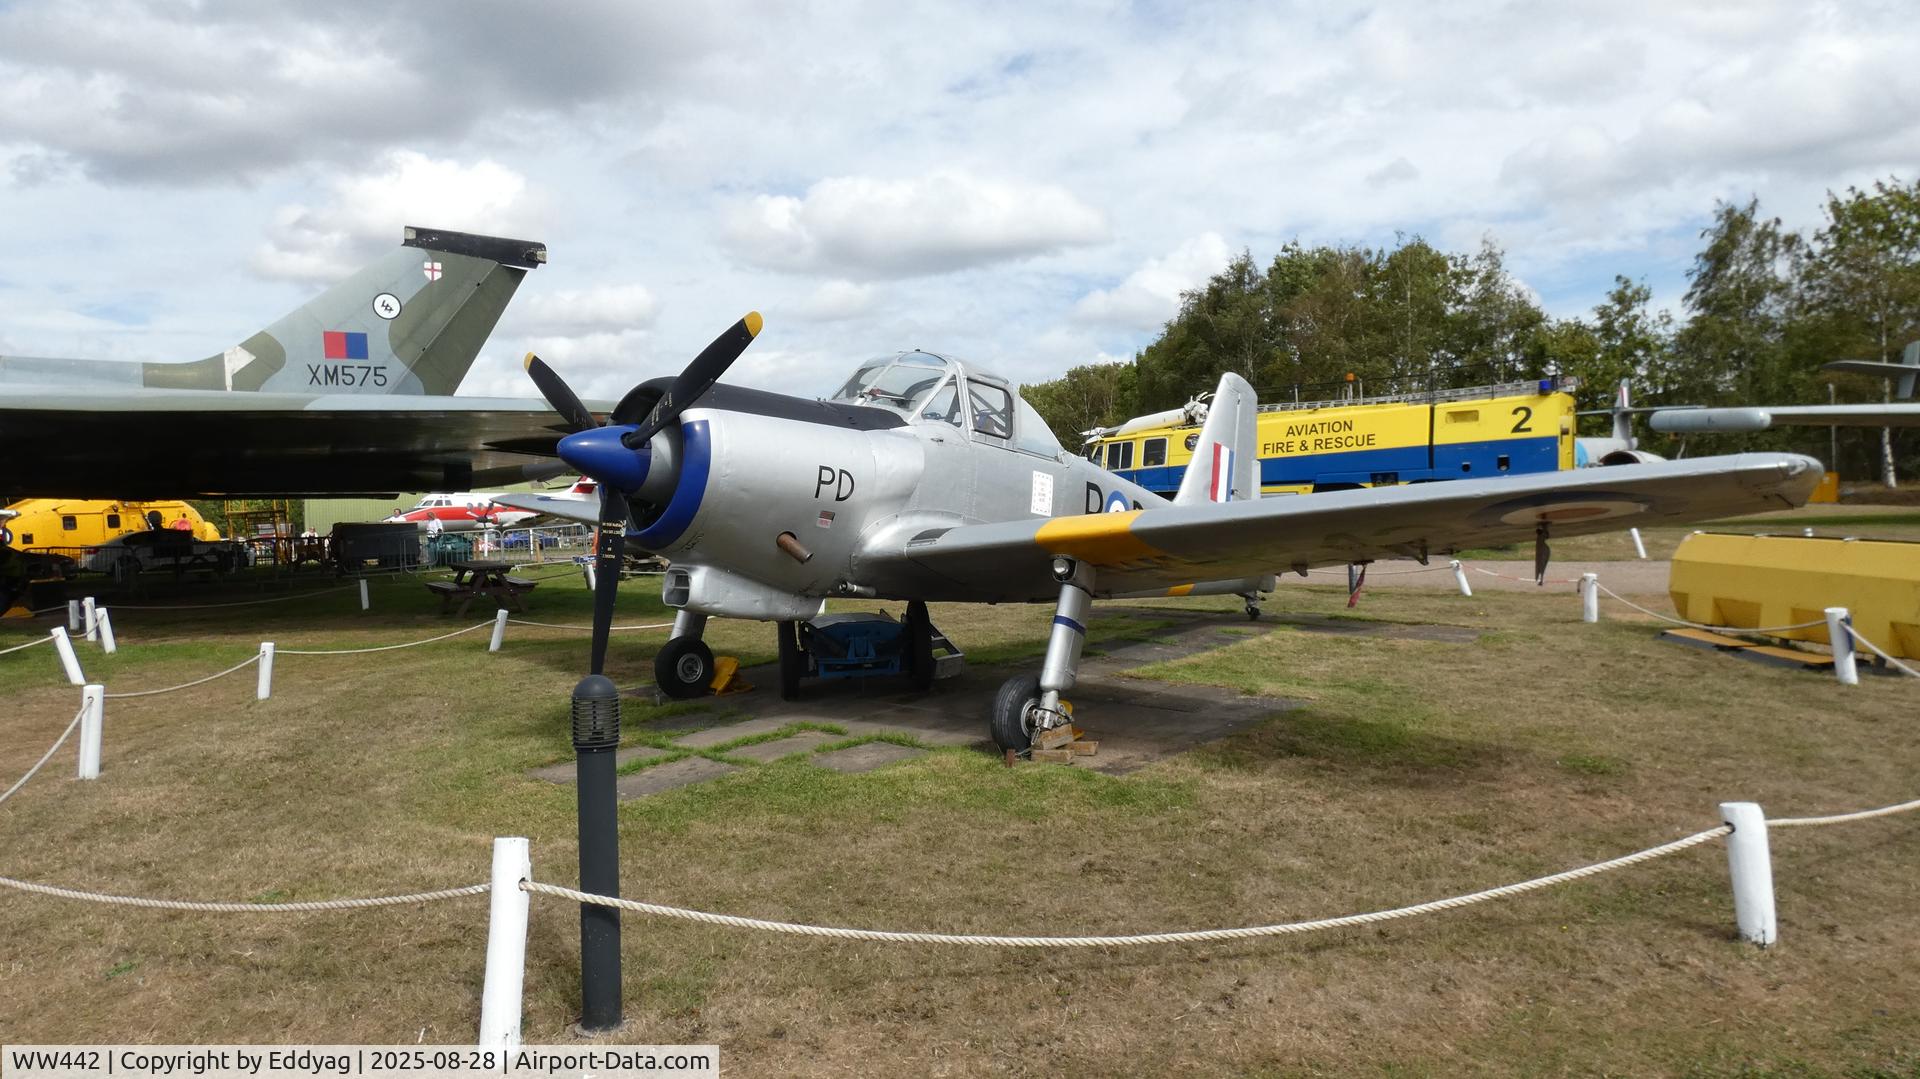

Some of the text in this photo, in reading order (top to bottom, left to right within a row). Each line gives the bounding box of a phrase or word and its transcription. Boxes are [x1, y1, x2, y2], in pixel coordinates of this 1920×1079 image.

[307, 364, 388, 387] XM575
[1286, 420, 1353, 437] AVIATION
[1511, 406, 1533, 434] 2
[1263, 433, 1376, 455] FIRE & RESCUE
[814, 465, 855, 502] PD
